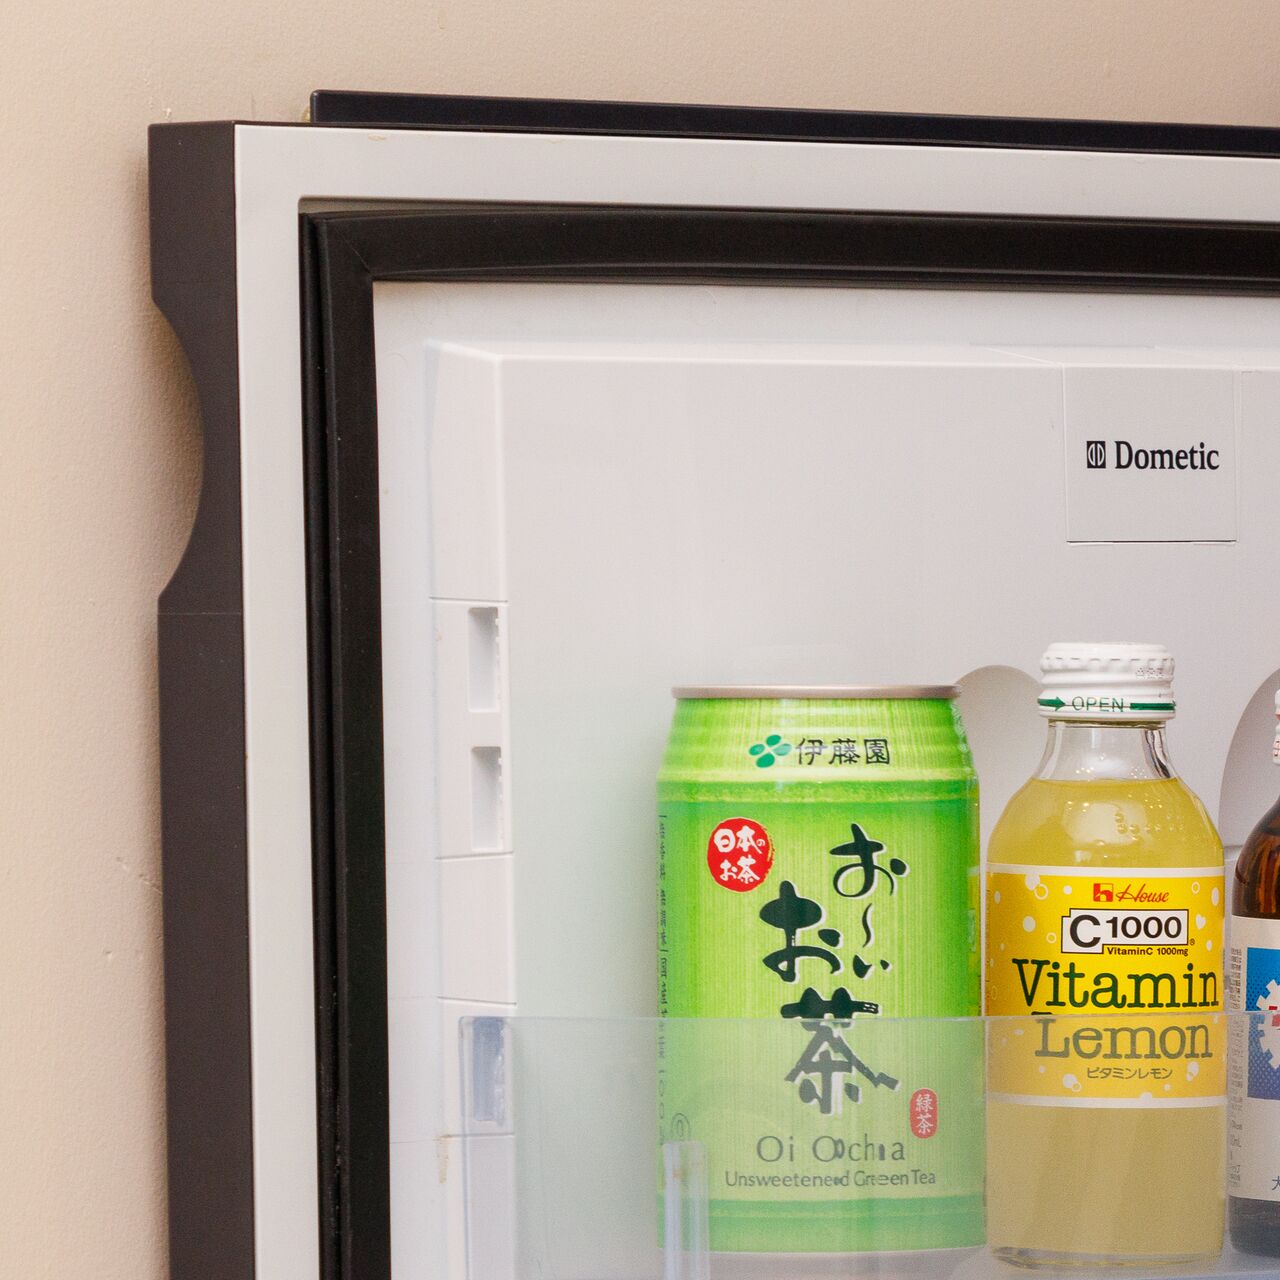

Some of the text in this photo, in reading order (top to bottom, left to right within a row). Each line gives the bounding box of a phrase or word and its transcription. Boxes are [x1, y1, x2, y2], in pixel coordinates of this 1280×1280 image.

[1114, 441, 1220, 470] Dometic
[1072, 696, 1124, 713] OPEN
[796, 738, 890, 766] 伊藤園
[713, 825, 766, 855] 日本の
[719, 854, 761, 885] お茶
[1115, 883, 1170, 902] House
[1069, 914, 1182, 948] C1000
[1157, 946, 1189, 957] 1000mg
[760, 880, 899, 1115] お茶
[1012, 958, 1220, 1009] Vitamin
[1031, 1011, 1213, 1060] Lemon
[1087, 1067, 1173, 1080] ビタミンレモン
[915, 1093, 934, 1135] 緑茶
[756, 1135, 795, 1162] Oi
[725, 1170, 849, 1188] Unsweetened
[911, 1168, 937, 1185] Tea
